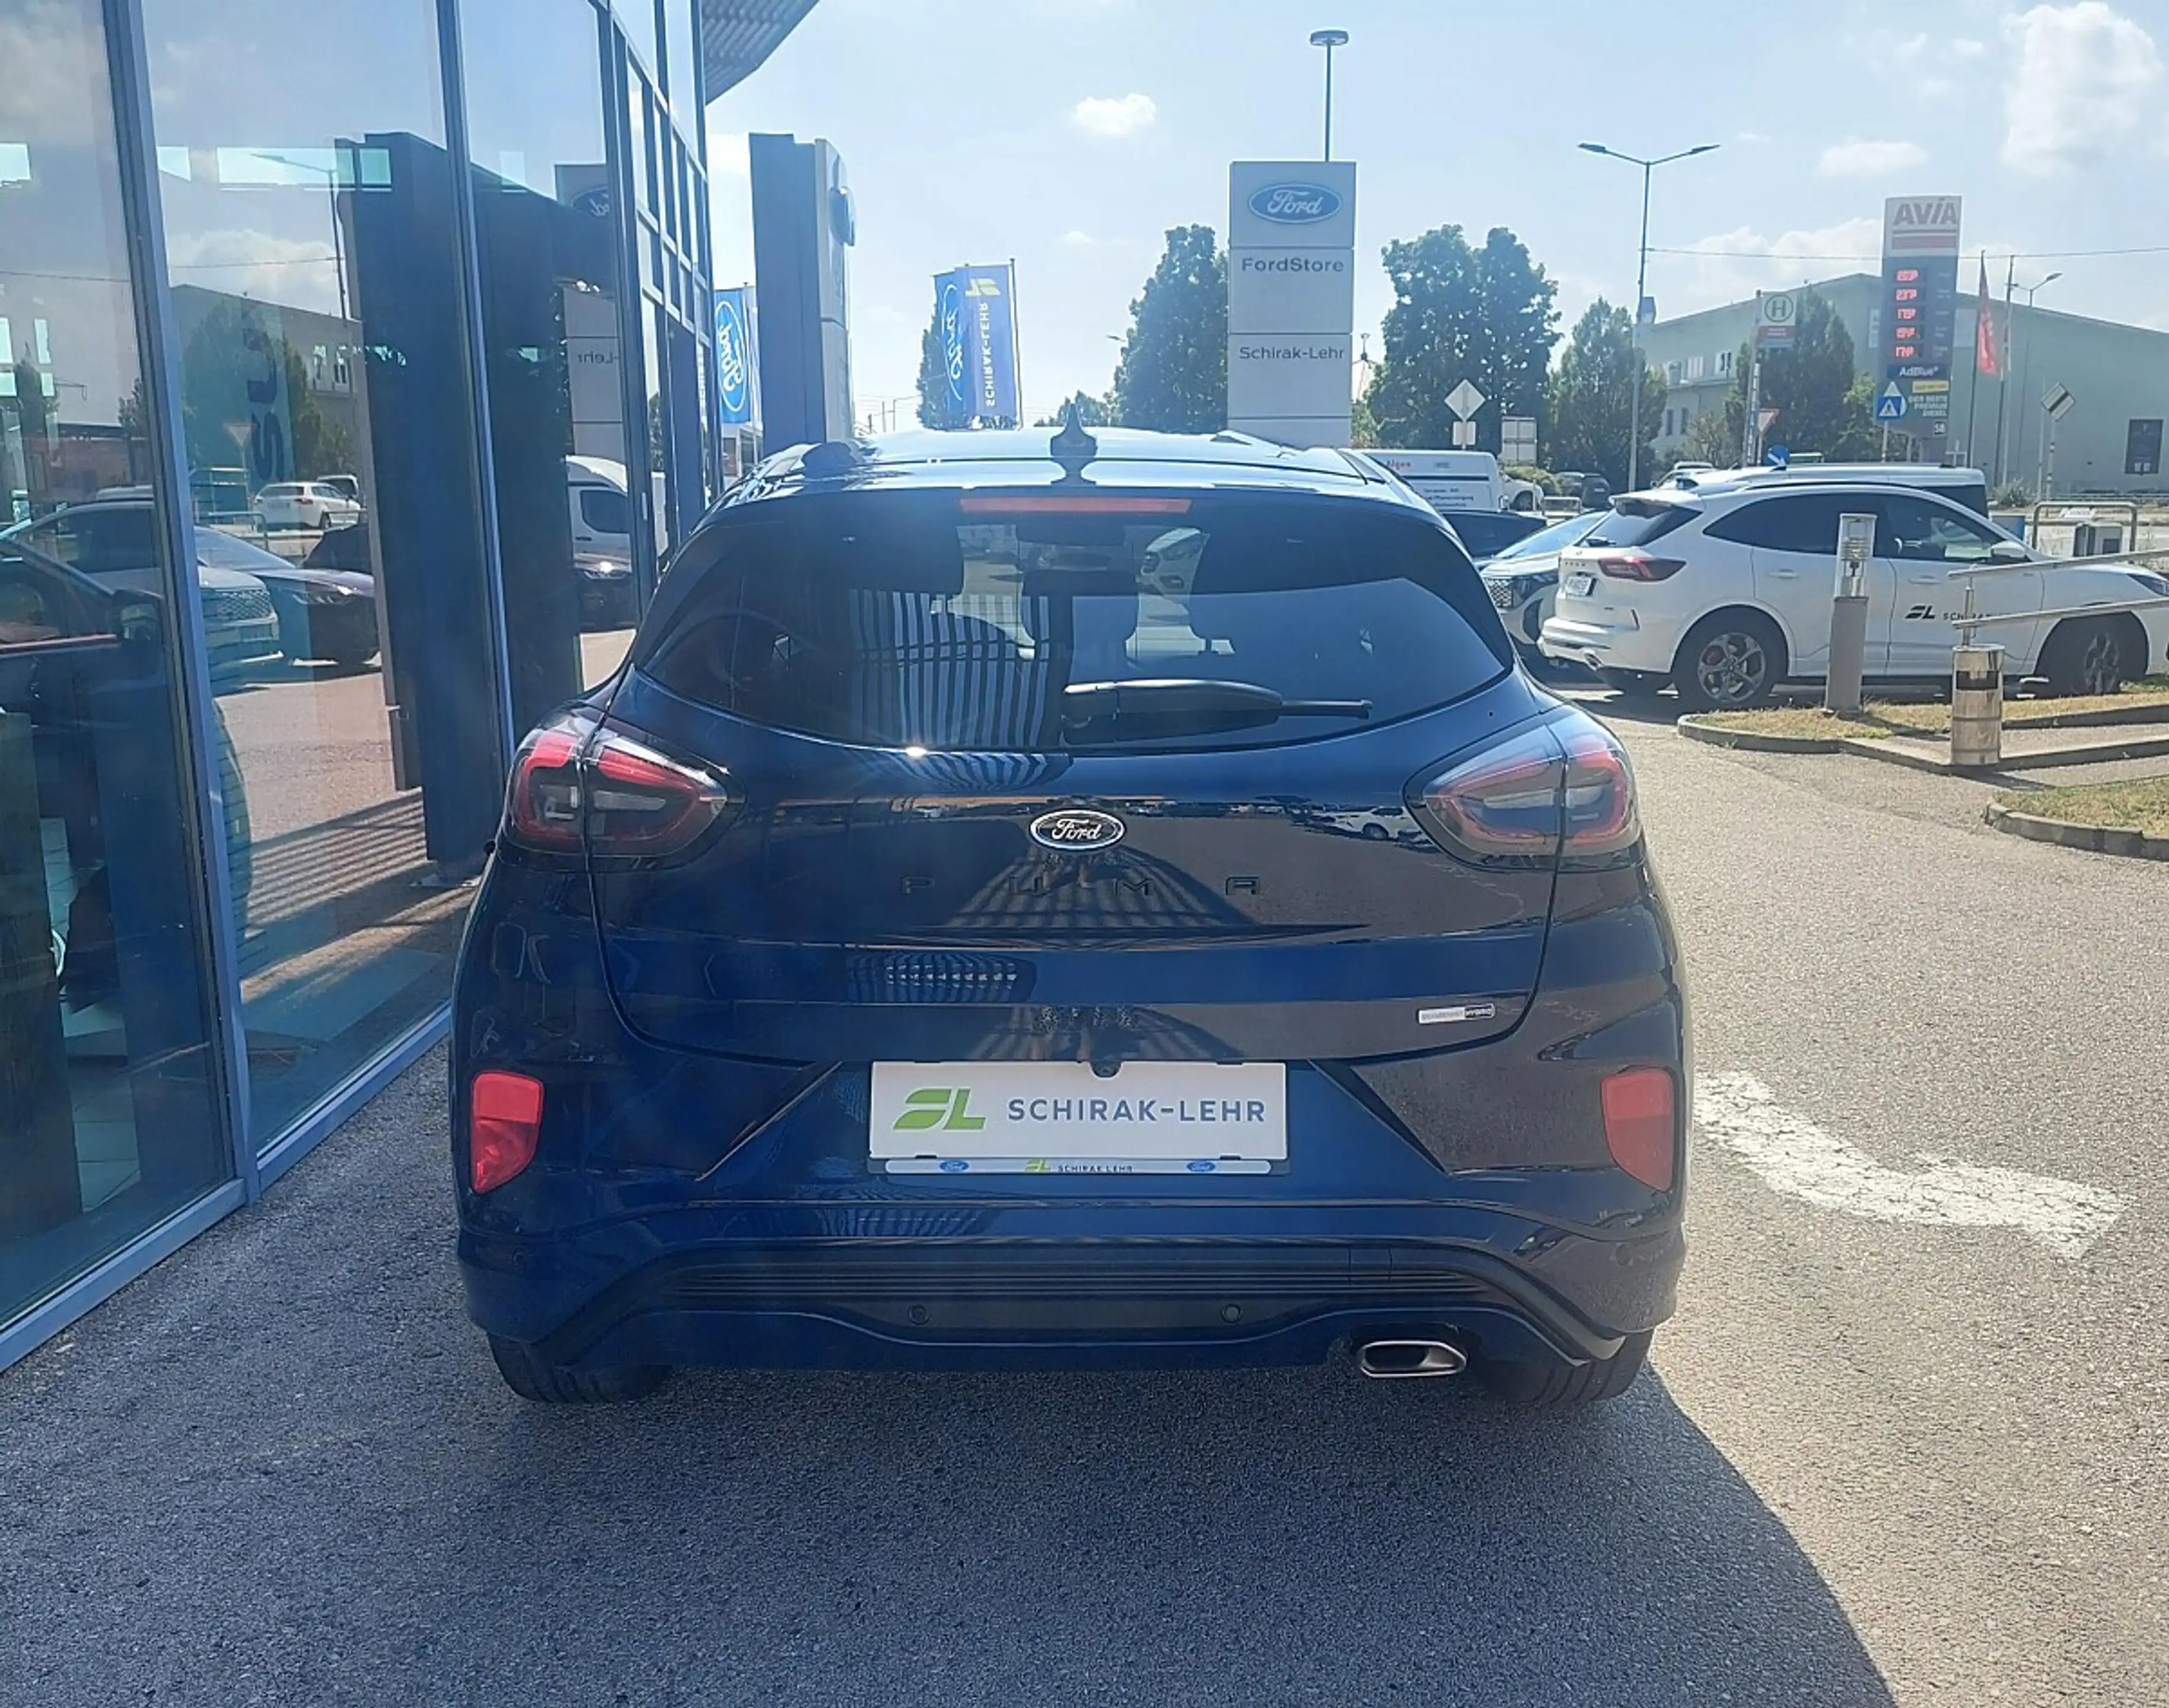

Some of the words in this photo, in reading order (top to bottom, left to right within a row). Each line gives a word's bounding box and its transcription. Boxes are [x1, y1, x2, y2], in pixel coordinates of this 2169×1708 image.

[1266, 189, 1323, 215] Ford
[1893, 202, 1957, 225] AVIA
[1241, 257, 1344, 272] FordStore
[1772, 300, 1786, 317] H
[1239, 346, 1345, 360] Schirak-Lehr
[1051, 818, 1102, 841] Ford
[1008, 1098, 1265, 1122] SCHIRAK-LEHR
